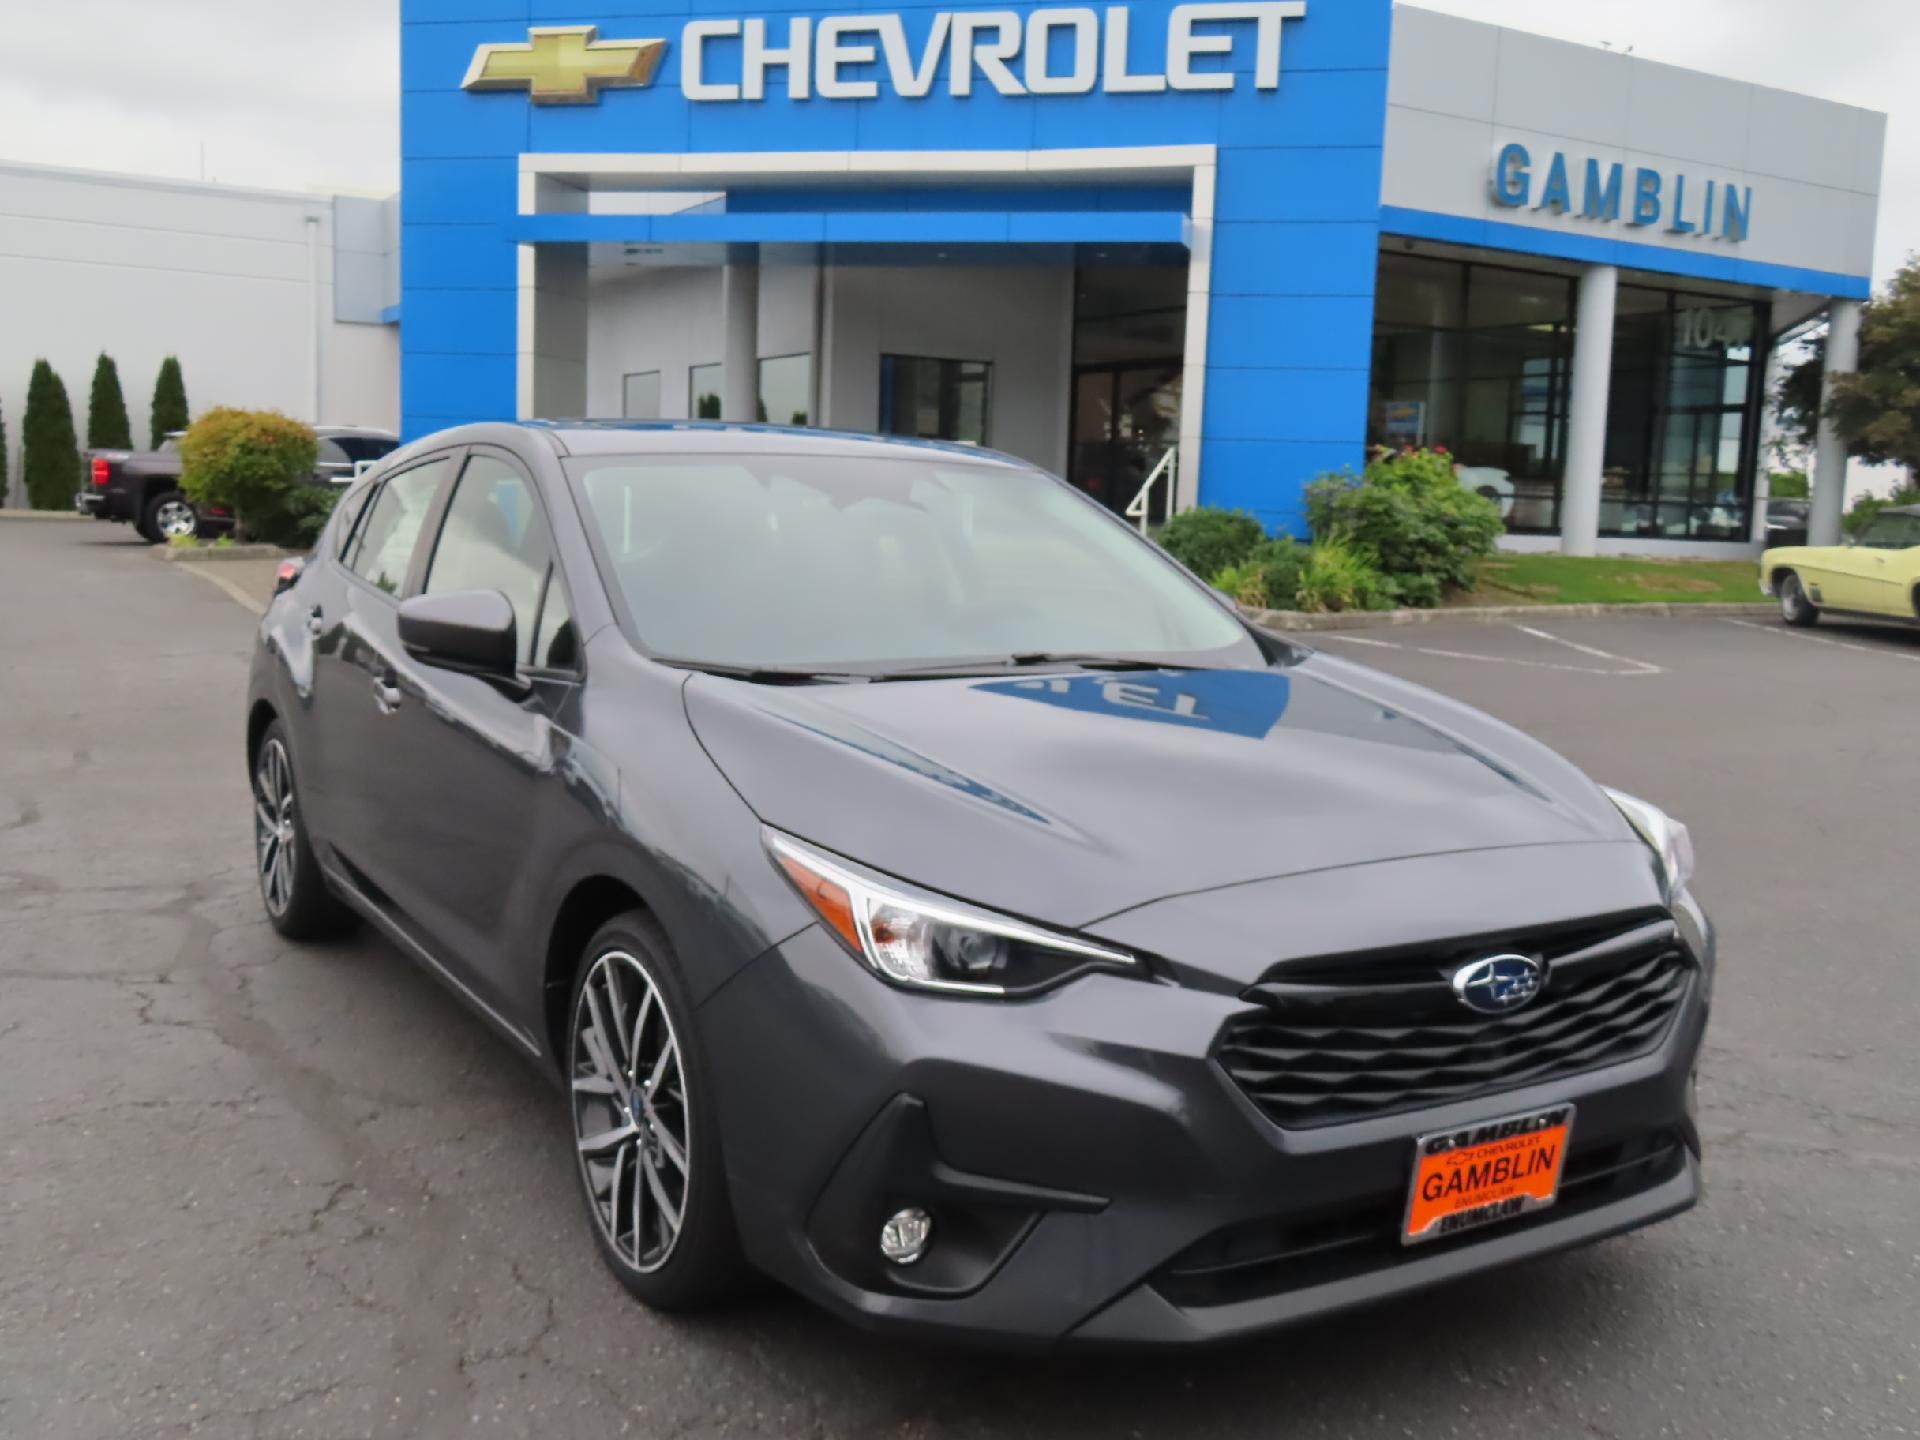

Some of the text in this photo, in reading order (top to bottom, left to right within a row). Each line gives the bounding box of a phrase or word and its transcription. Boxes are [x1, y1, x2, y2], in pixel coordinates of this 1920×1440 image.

[681, 1, 1306, 101] CHEVROLET
[1496, 143, 1752, 241] GAMBLIN
[1422, 1144, 1556, 1202] GAMBLIN
